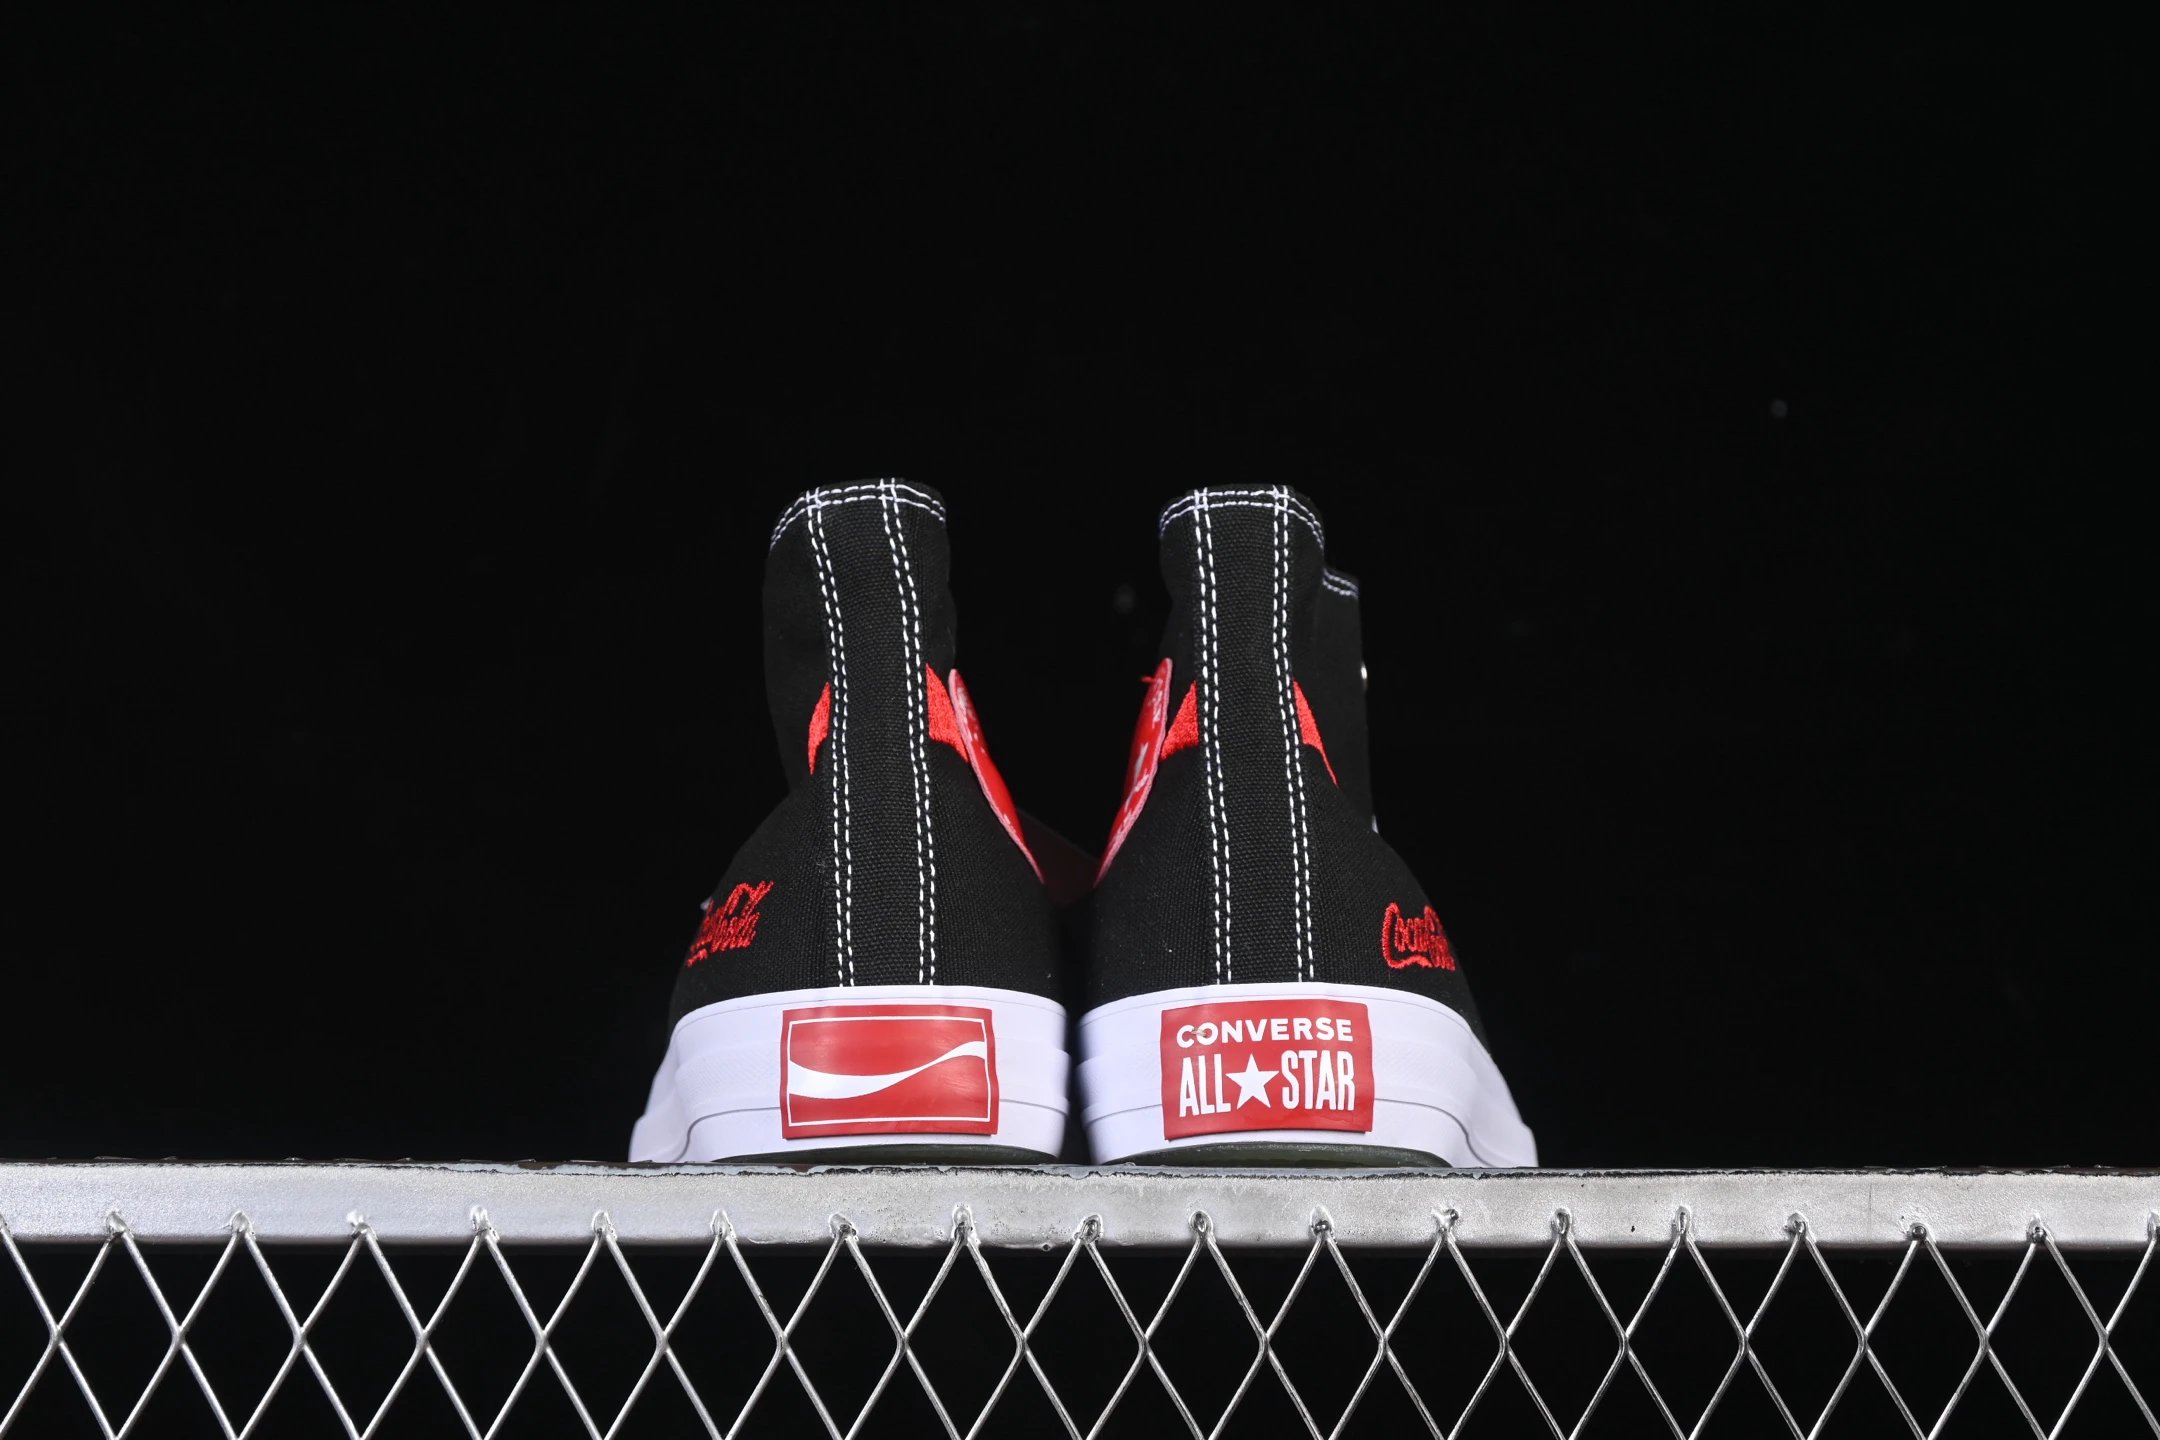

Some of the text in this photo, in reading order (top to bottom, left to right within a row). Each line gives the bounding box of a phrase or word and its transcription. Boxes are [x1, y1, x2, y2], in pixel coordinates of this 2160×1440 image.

[1176, 1017, 1353, 1048] CONVERSE
[1179, 1050, 1355, 1117] ALL STAR
